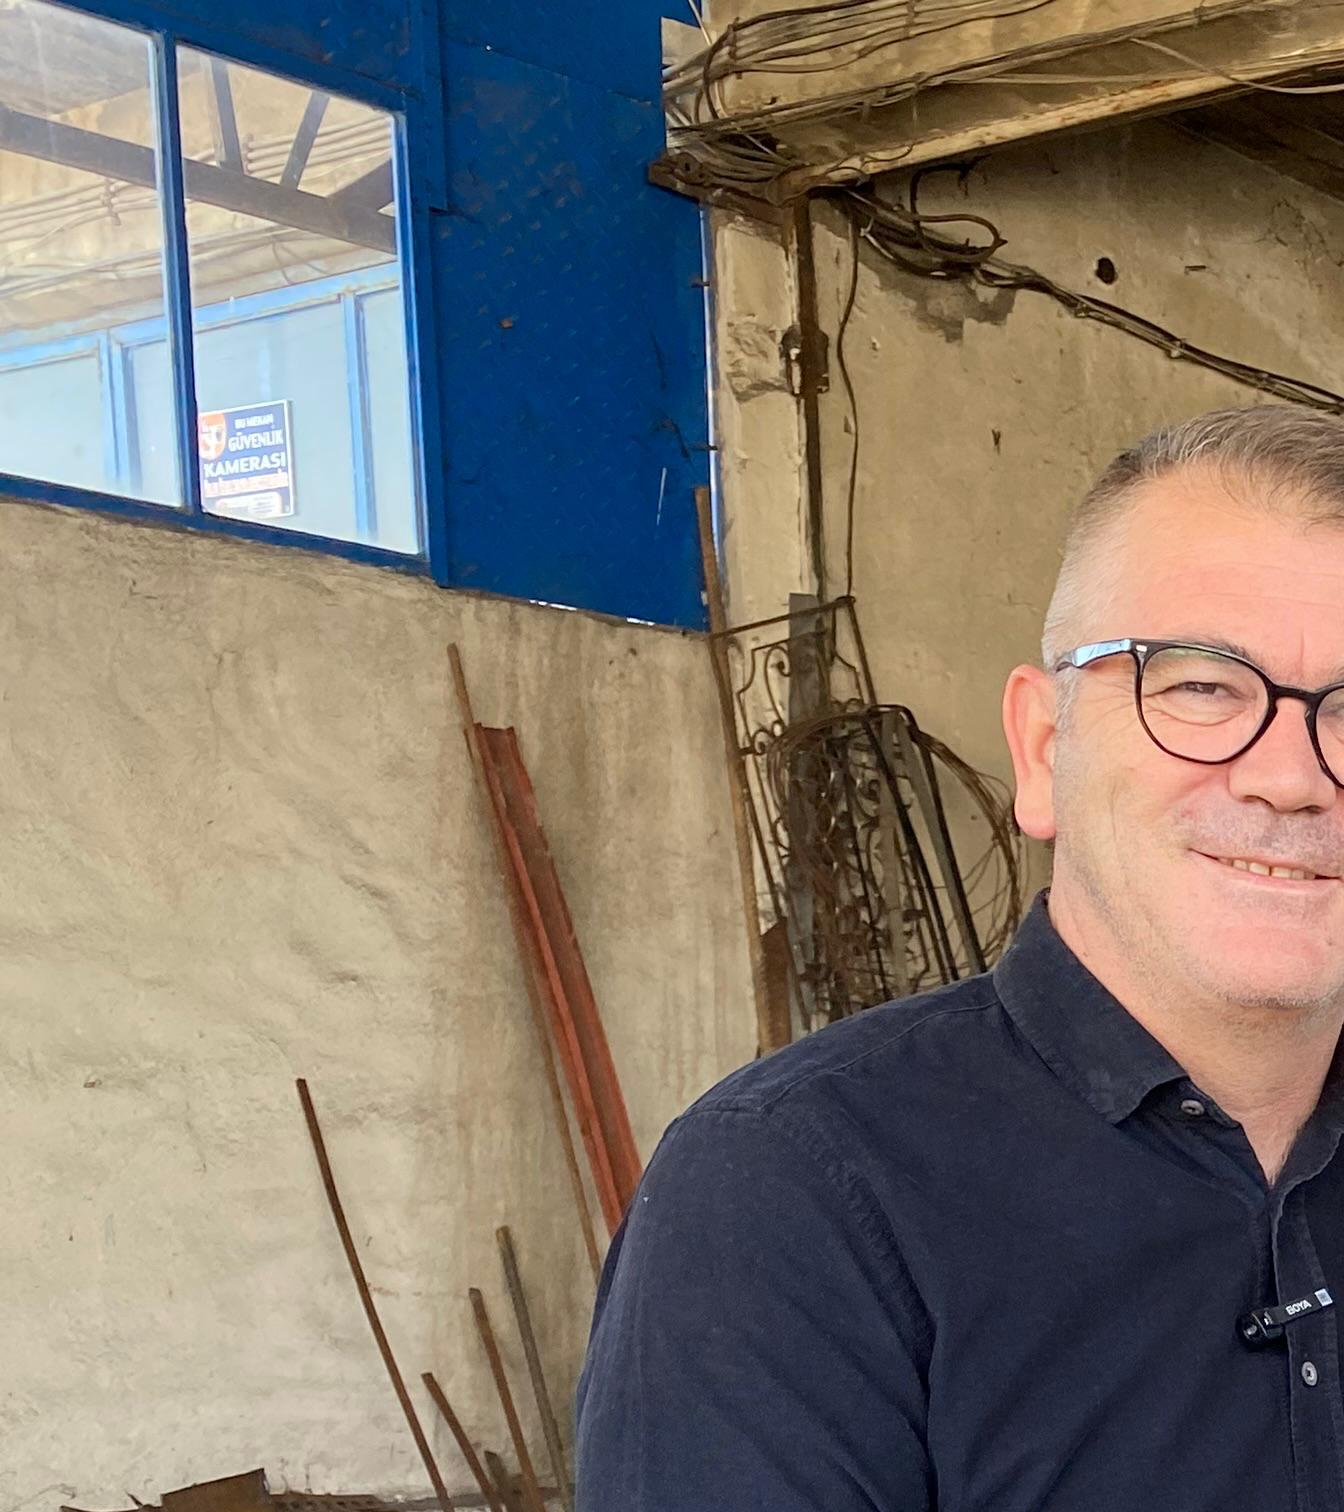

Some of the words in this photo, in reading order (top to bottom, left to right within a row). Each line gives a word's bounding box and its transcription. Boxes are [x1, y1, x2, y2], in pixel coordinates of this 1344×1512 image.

[228, 426, 284, 452] GÜVENLİK
[204, 452, 286, 478] KAMERASI
[1285, 1299, 1312, 1315] BOYA
